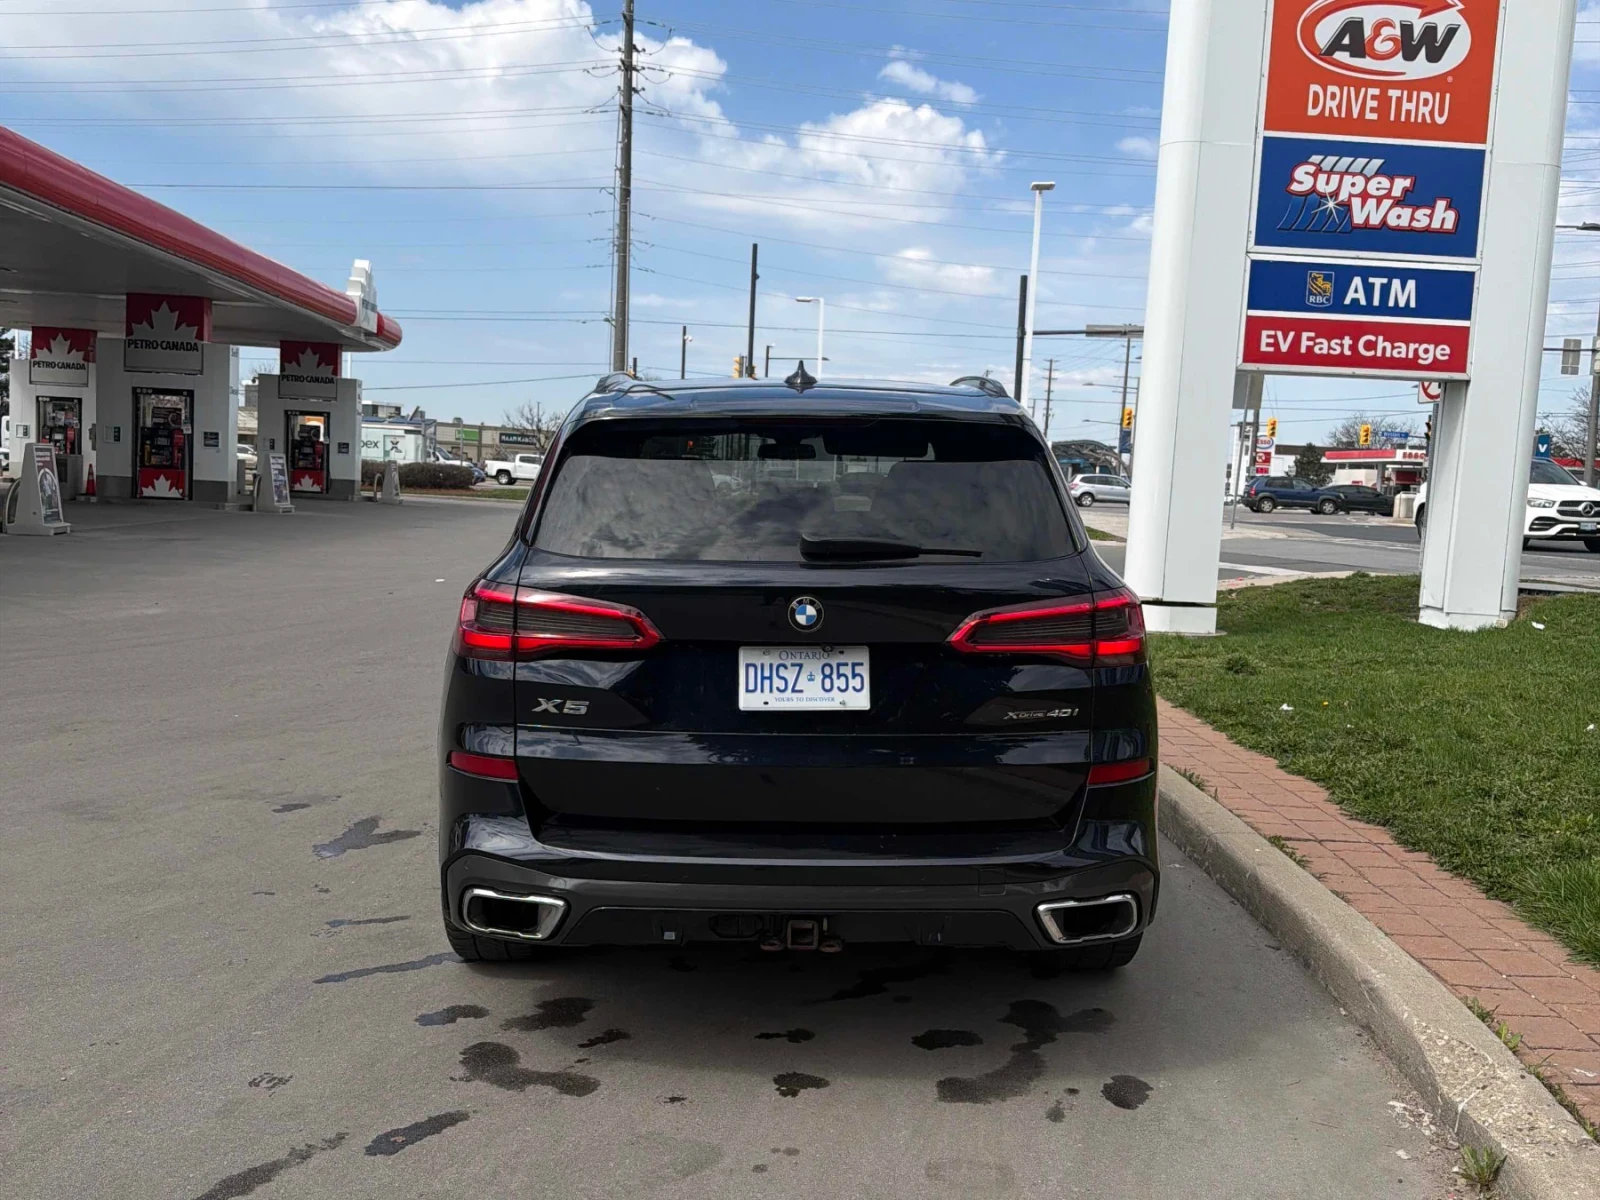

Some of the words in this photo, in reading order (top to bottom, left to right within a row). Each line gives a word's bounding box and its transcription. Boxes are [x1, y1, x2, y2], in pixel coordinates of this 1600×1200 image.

[1319, 17, 1461, 64] A&W
[1306, 83, 1381, 120] DRIVE
[1387, 88, 1451, 125] THRU
[1287, 162, 1415, 205] Super
[1350, 197, 1460, 233] Wash
[1308, 294, 1329, 304] RBC
[1343, 276, 1417, 309] ATM
[1259, 329, 1296, 353] EV
[1300, 331, 1353, 356] Fast
[1358, 335, 1451, 365] Charge
[779, 650, 831, 661] ONTARIO
[744, 662, 804, 694] DHSZ
[820, 662, 865, 693] 855
[531, 697, 590, 715] X5
